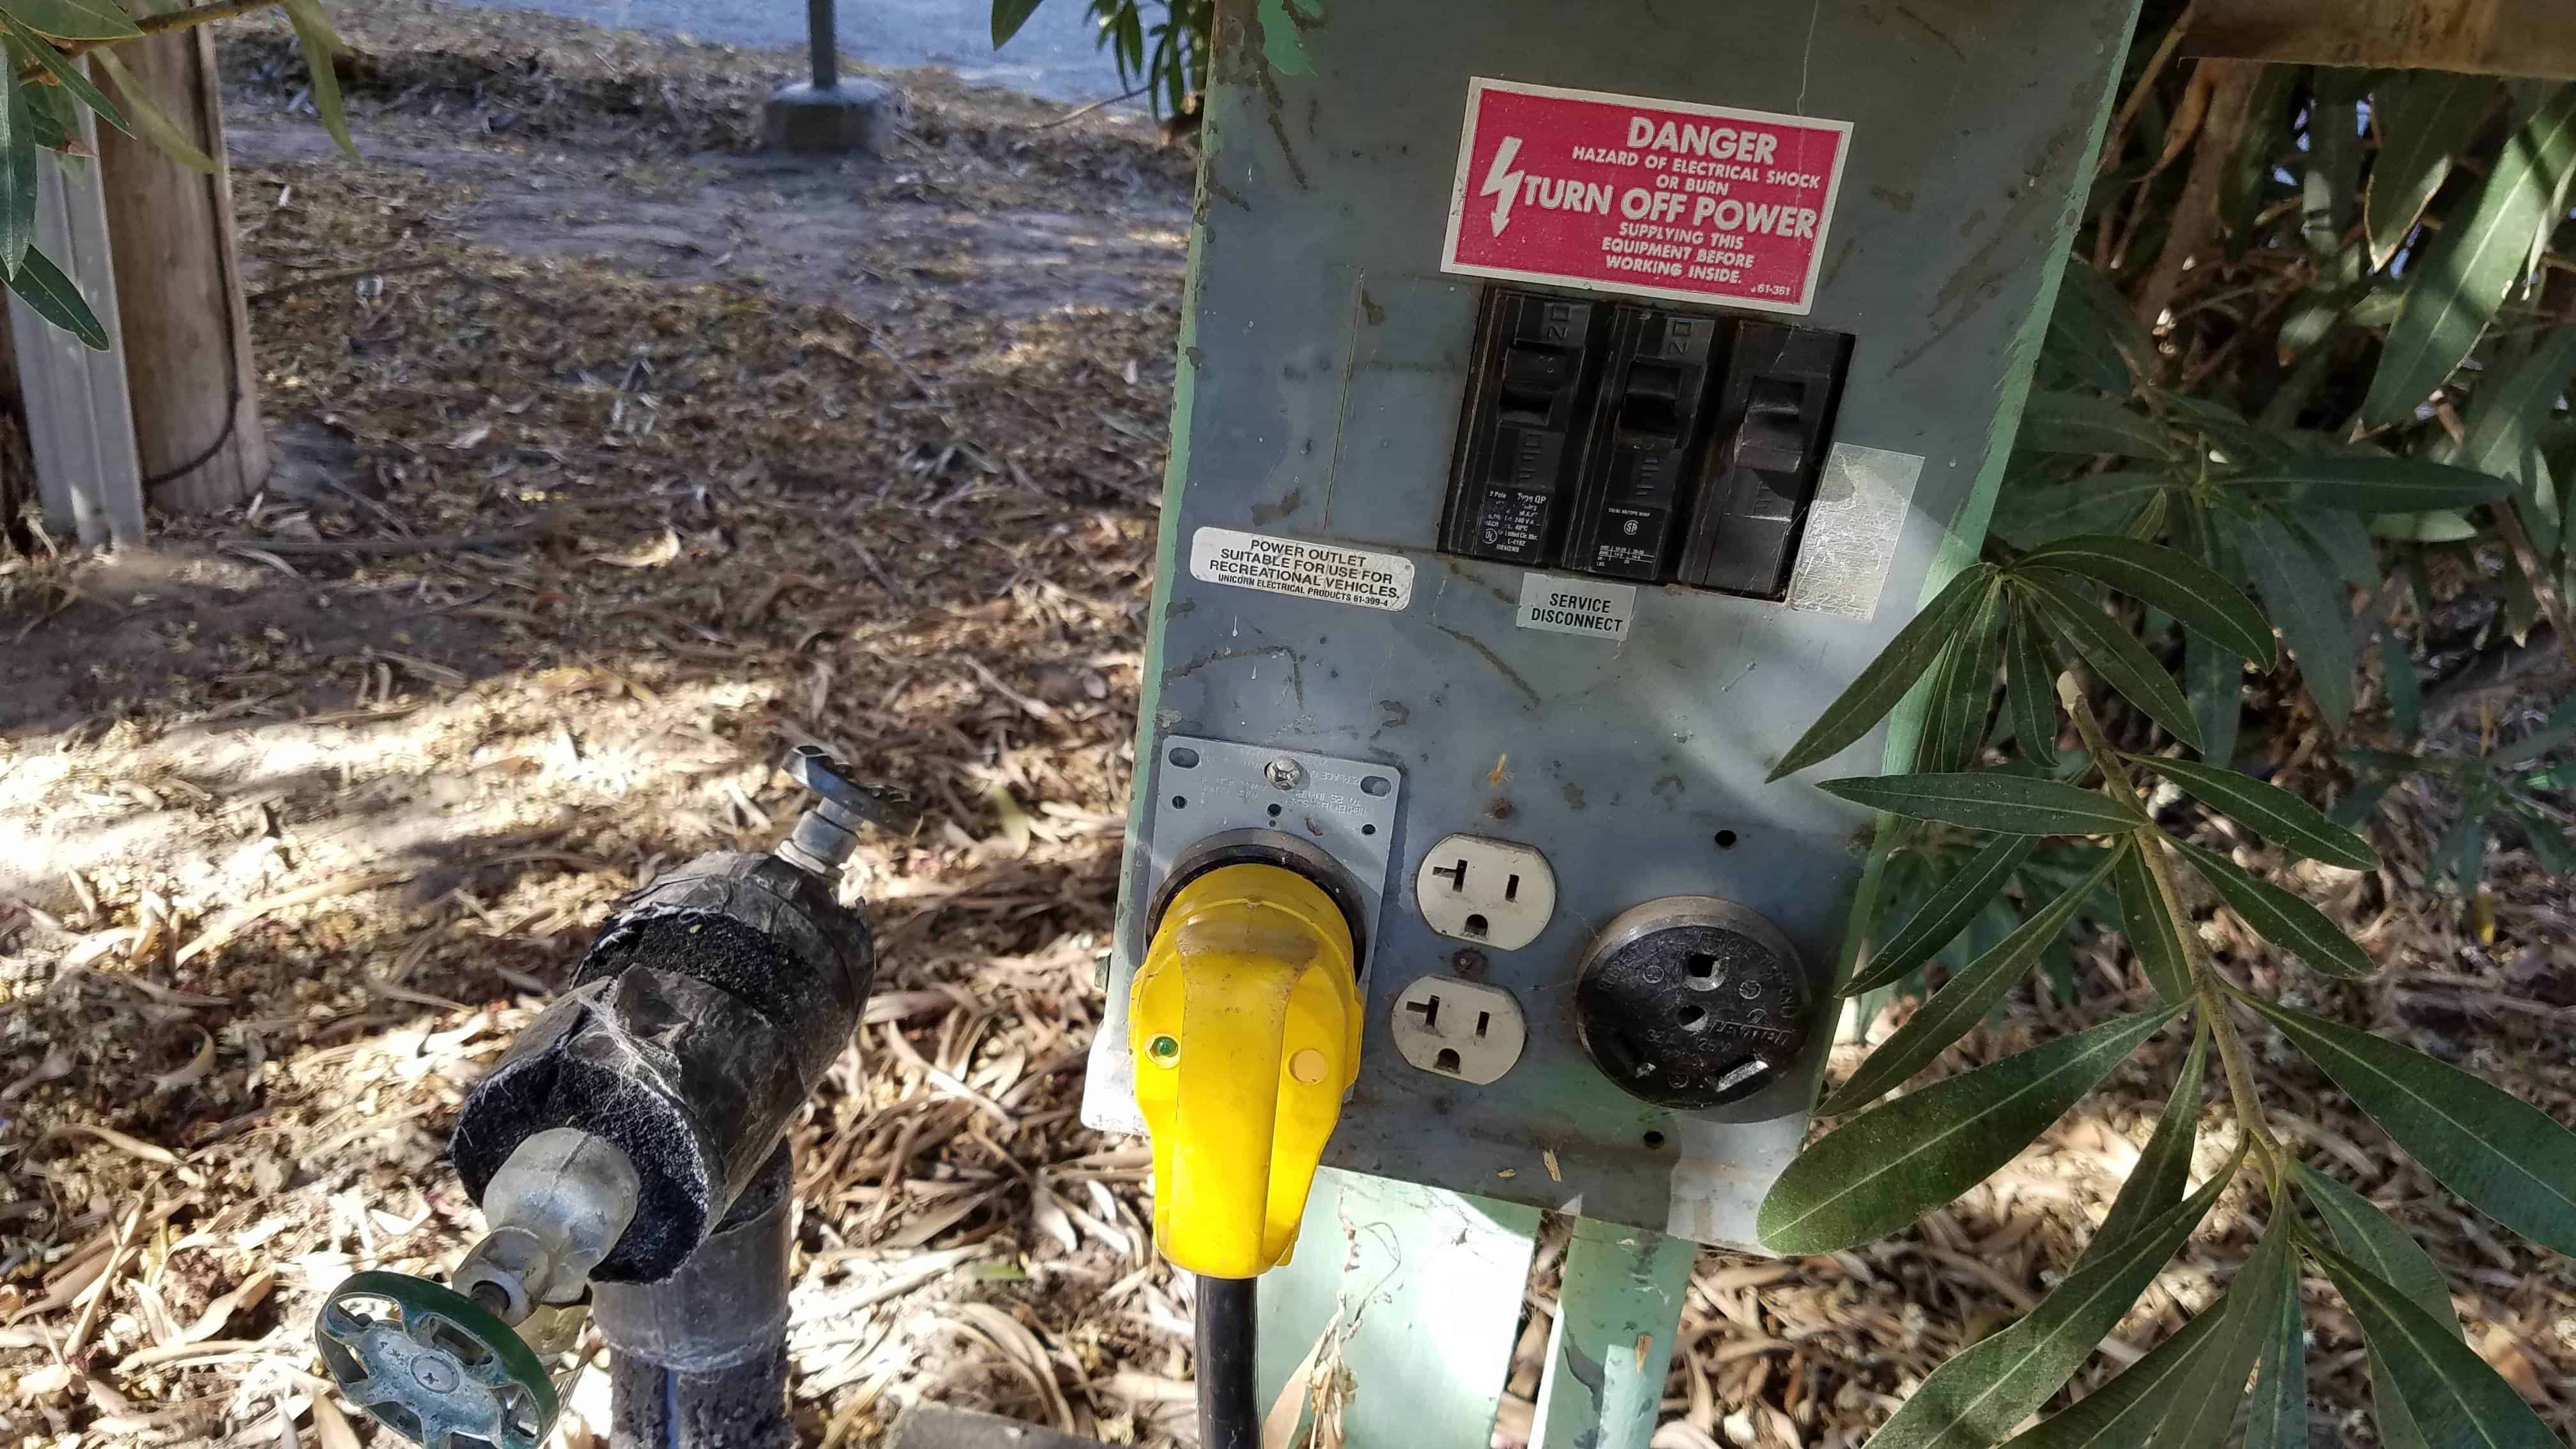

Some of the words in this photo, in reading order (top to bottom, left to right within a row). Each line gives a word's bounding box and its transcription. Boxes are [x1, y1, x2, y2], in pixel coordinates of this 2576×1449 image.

[1627, 116, 1779, 165] DANGER
[1572, 146, 1639, 166] HAZARD
[1644, 154, 1667, 169] OF
[1671, 158, 1759, 183] ELECTRICAL
[1767, 169, 1821, 190] SHOCK
[1656, 174, 1679, 190] OR
[1685, 178, 1729, 195] BURN
[1524, 176, 1613, 215] TURN
[1620, 187, 1687, 223] OFF
[1694, 197, 1817, 239] POWER
[1618, 222, 1705, 245] SUPPLYING
[1710, 233, 1744, 249] THIS
[1602, 238, 1691, 261] EQUIPMENT
[1696, 250, 1754, 270] BEFORE
[1606, 256, 1682, 277] WORKING
[1689, 265, 1742, 284] INSIDE.
[1220, 549, 1290, 568] SUITABLE
[1294, 560, 1324, 574] FOR
[1328, 564, 1358, 579] USE
[1361, 570, 1393, 584] FOR
[1251, 540, 1304, 558] POWER
[1308, 549, 1366, 567] OUTLET
[1209, 560, 1321, 586] RECREATIONAL
[1325, 578, 1400, 599] VEHICLES.
[1218, 574, 1255, 586] UNICORN
[1257, 579, 1305, 594] ELECTRICAL
[1307, 587, 1351, 601] PRODUCTS
[1353, 595, 1388, 606] 61-399-4
[1549, 593, 1611, 613] SERVICE
[1531, 608, 1623, 632] DISCONNECT
